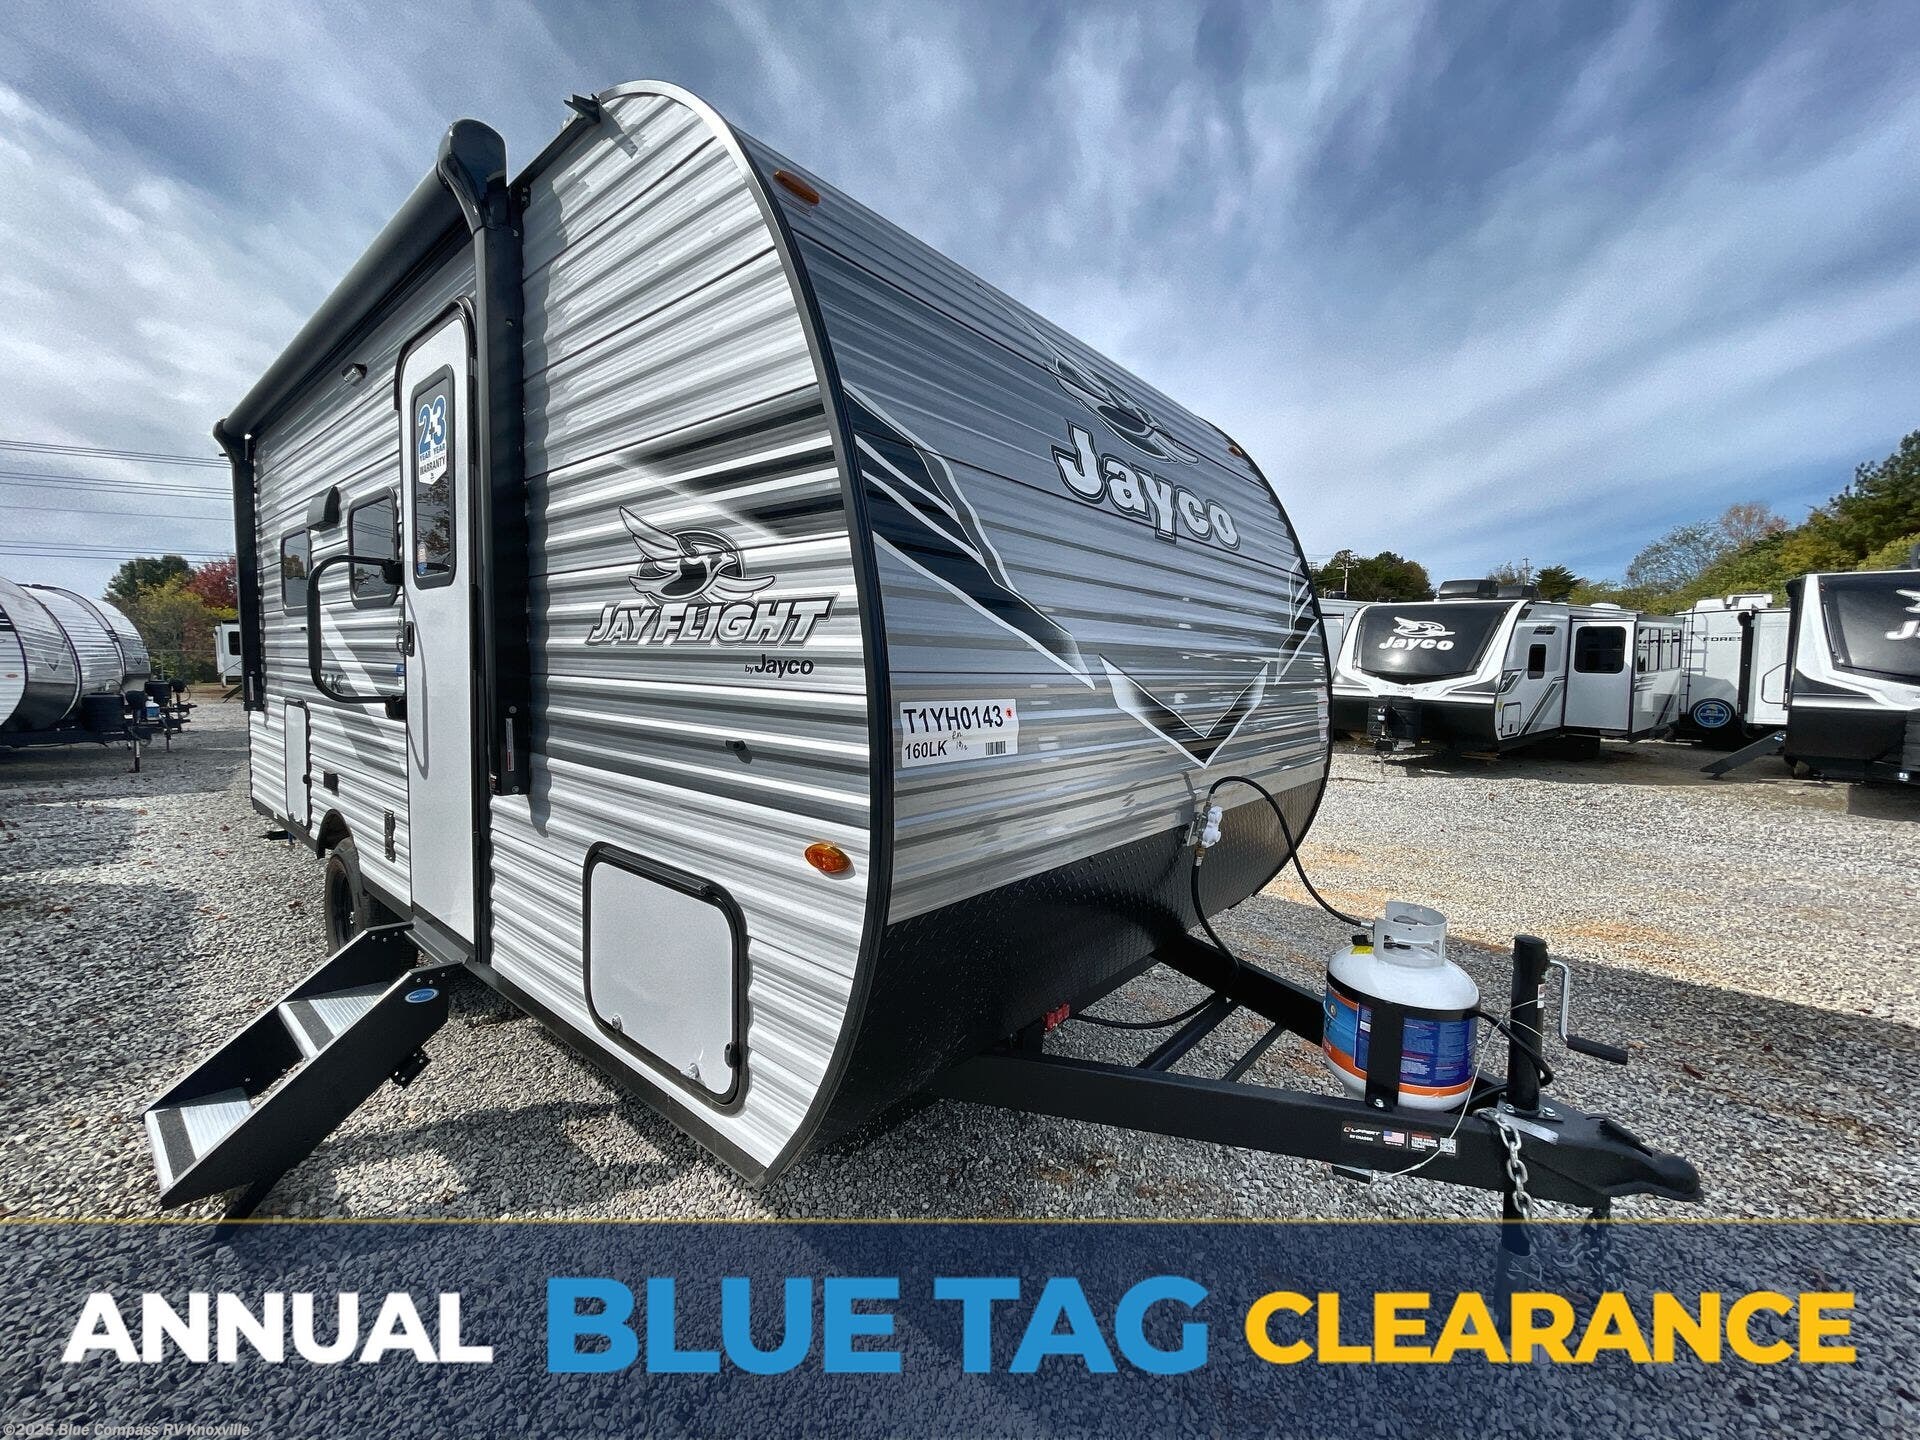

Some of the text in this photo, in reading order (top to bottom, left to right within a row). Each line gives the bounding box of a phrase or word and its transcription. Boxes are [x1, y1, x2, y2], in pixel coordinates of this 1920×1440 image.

[419, 455, 446, 476] WARRANTY
[1051, 419, 1241, 550] Jayco
[1379, 636, 1455, 651] Jayco
[744, 654, 814, 678] by Jayco
[903, 705, 1004, 733] T1YH0143
[904, 740, 948, 759] 160LK
